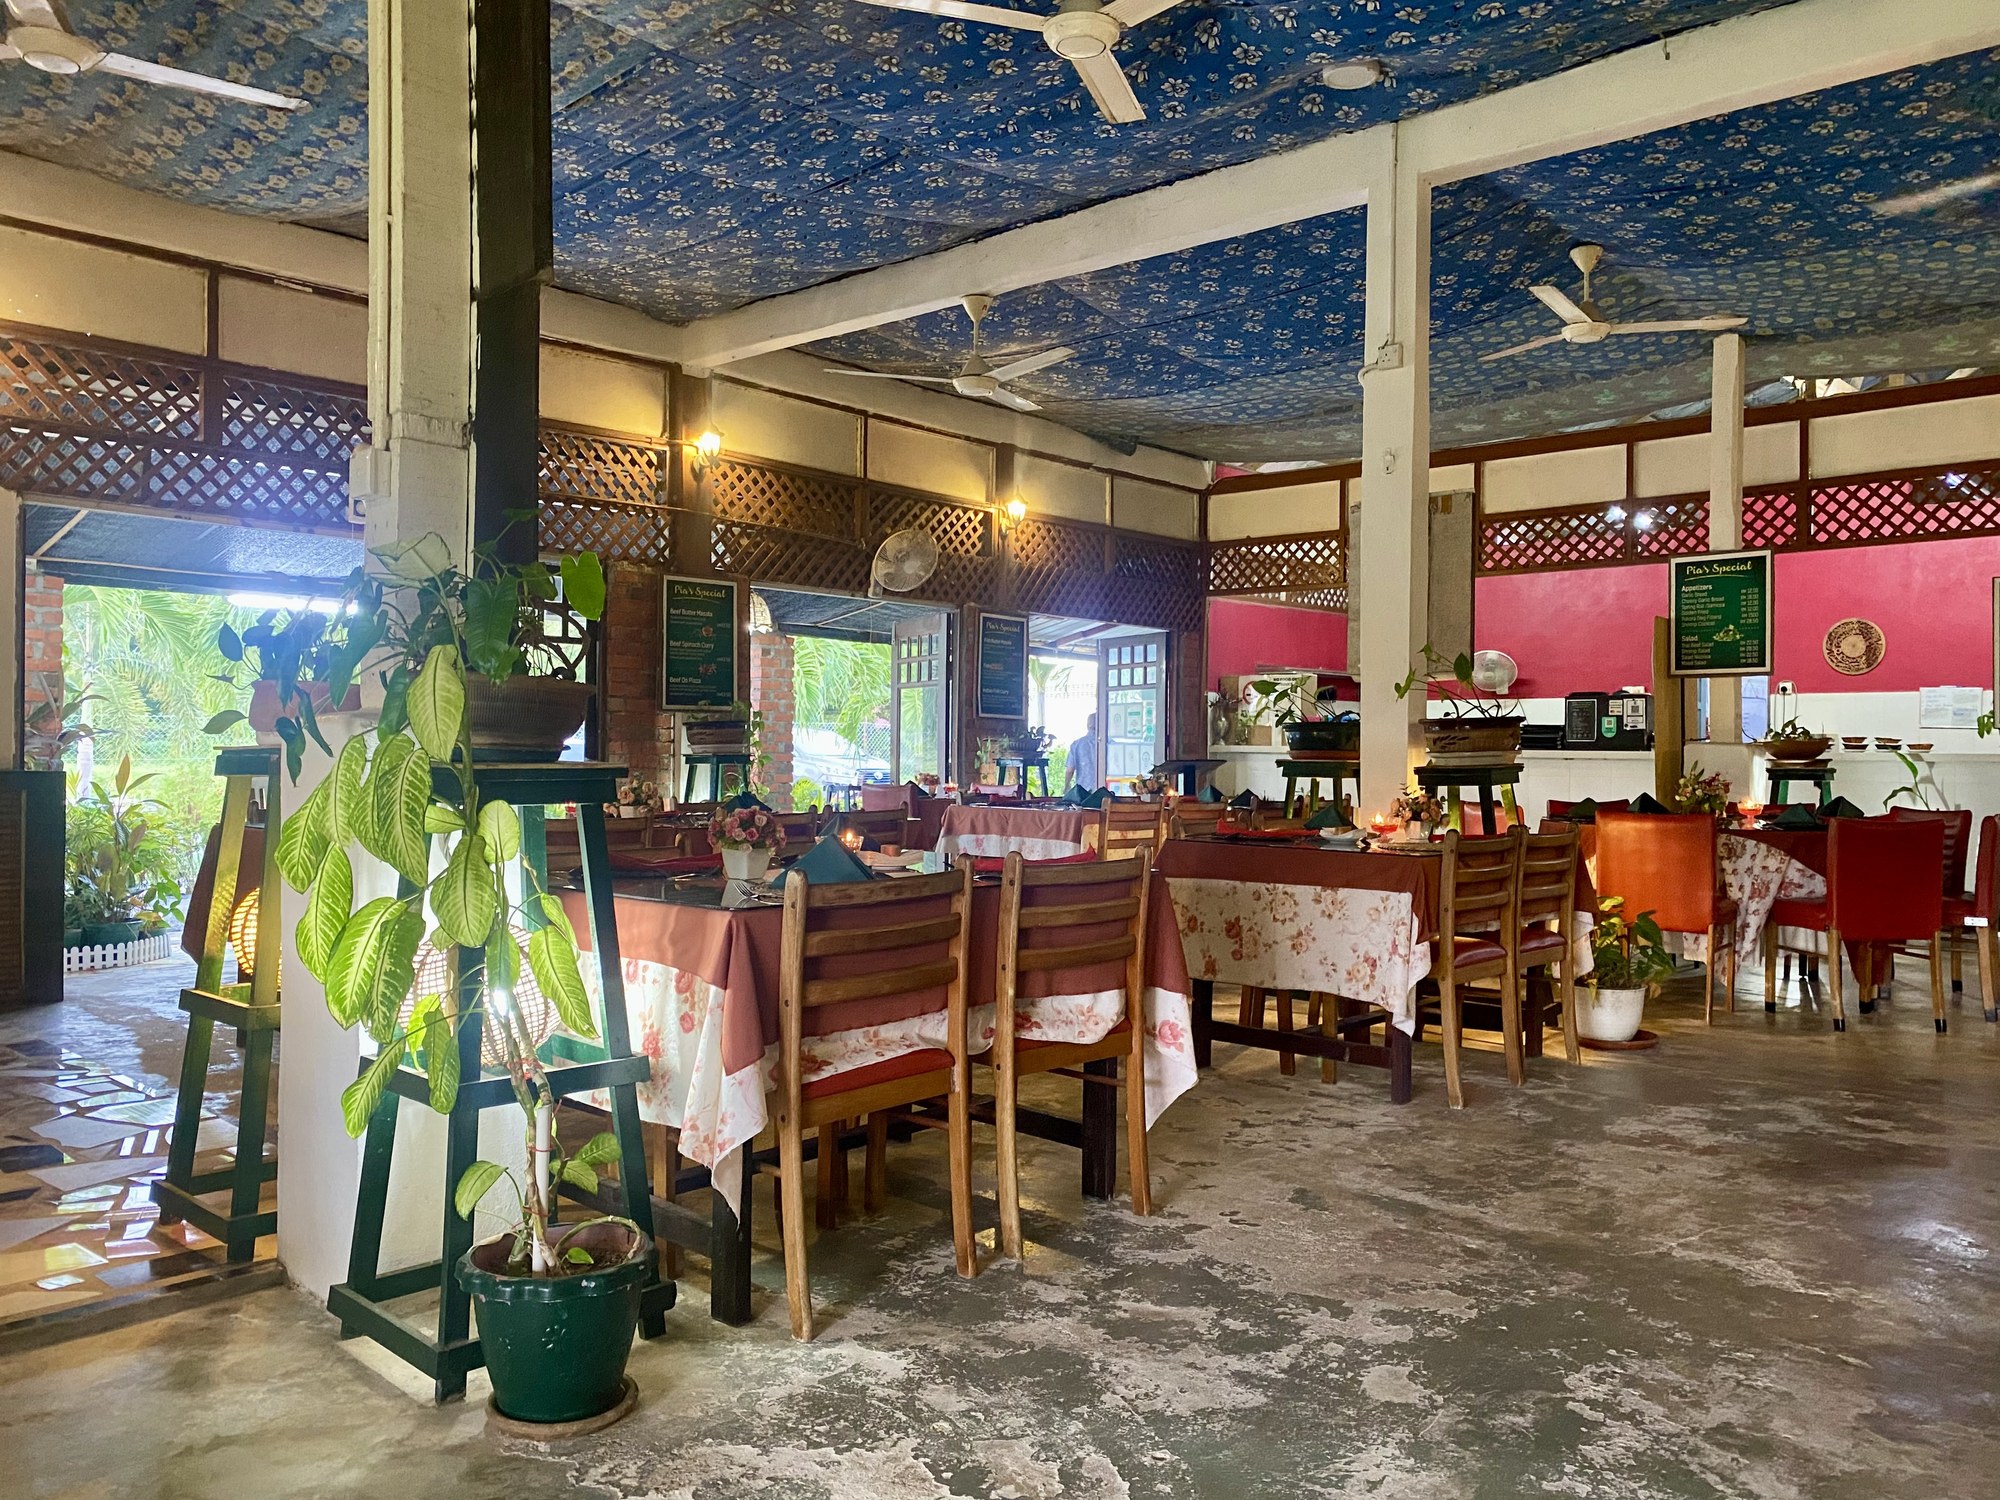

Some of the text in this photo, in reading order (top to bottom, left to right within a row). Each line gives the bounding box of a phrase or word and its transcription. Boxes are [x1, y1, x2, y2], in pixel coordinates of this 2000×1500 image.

[1686, 561, 1752, 574] Pia's Special
[695, 587, 725, 598] Special
[701, 642, 714, 650] Curry
